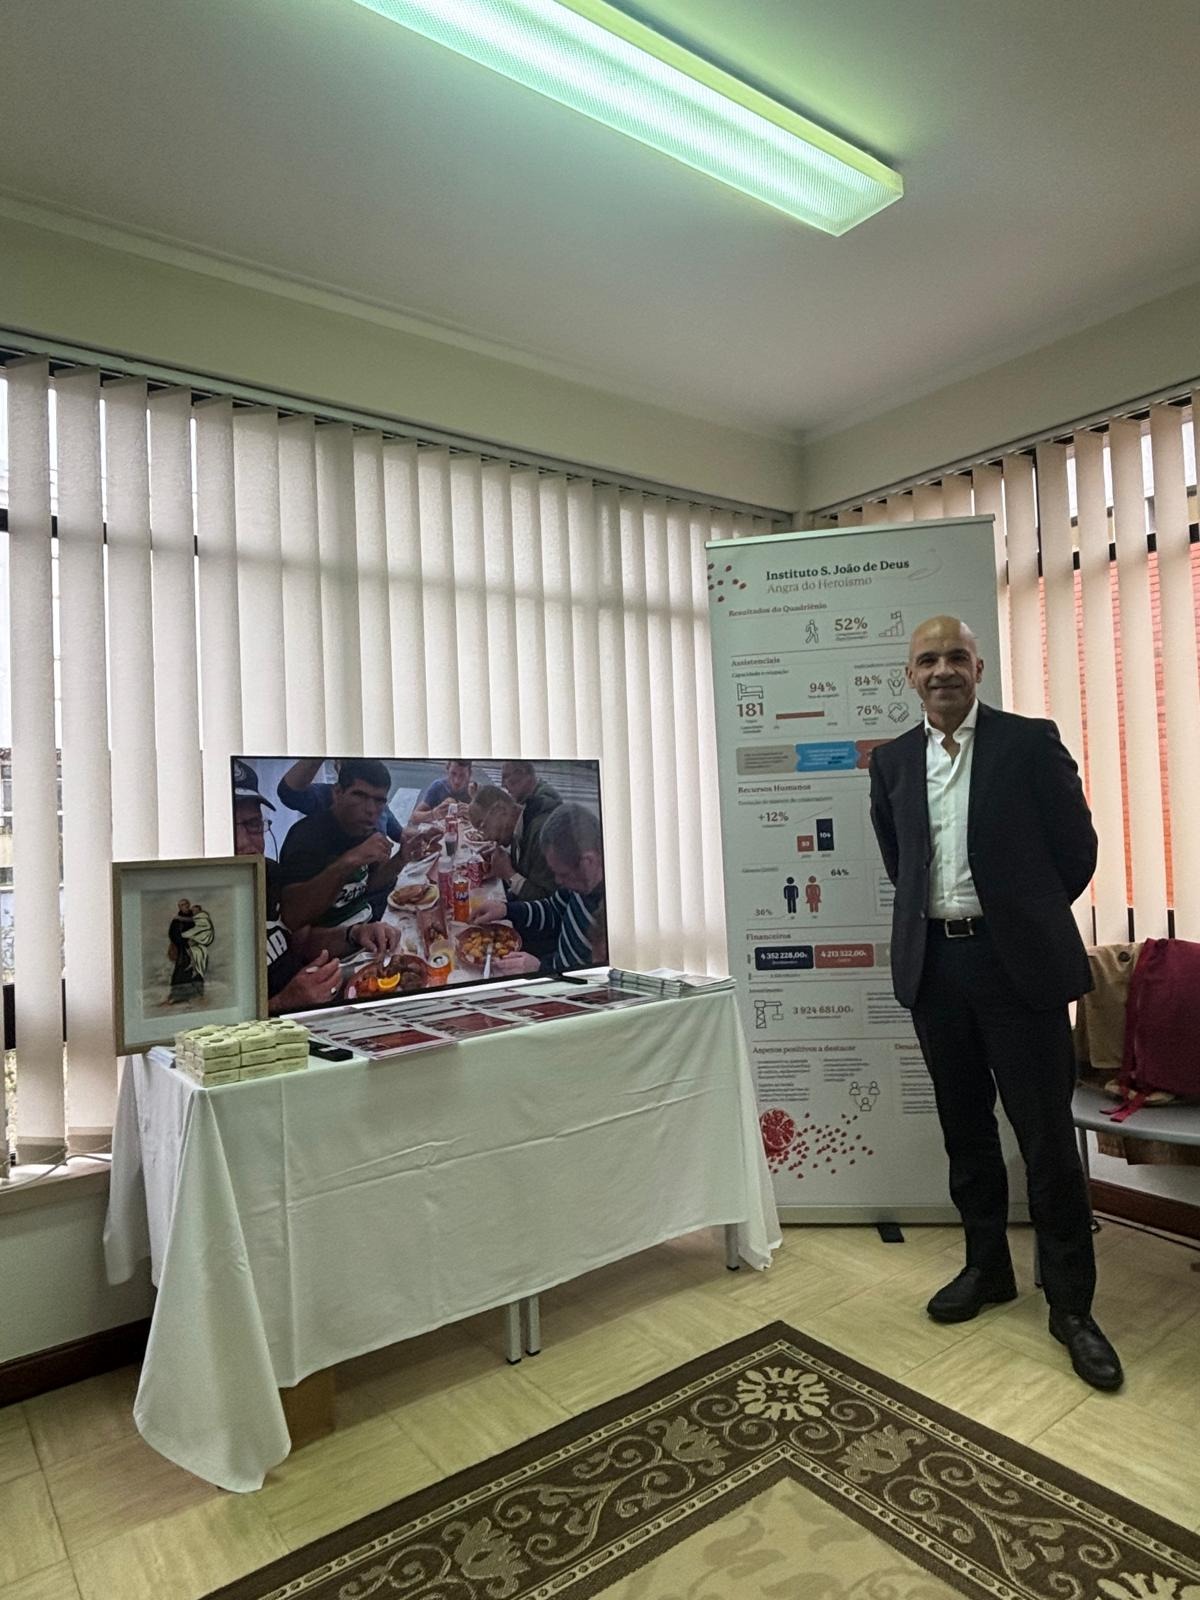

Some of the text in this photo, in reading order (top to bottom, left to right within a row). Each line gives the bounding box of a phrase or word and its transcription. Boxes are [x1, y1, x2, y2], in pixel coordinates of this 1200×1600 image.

[766, 560, 910, 581] Instituto S. João de Deus
[767, 576, 873, 594] Angra do Heroísmo
[772, 605, 782, 613] do
[834, 617, 868, 632] 52%
[810, 681, 837, 693] 94%
[854, 675, 882, 687] 84%
[736, 702, 764, 718] 181
[856, 704, 884, 717] 76%
[738, 783, 811, 793] Recursos Humanos
[758, 811, 789, 822] +12%
[830, 868, 849, 876] 64%
[746, 932, 792, 941] Financeiros
